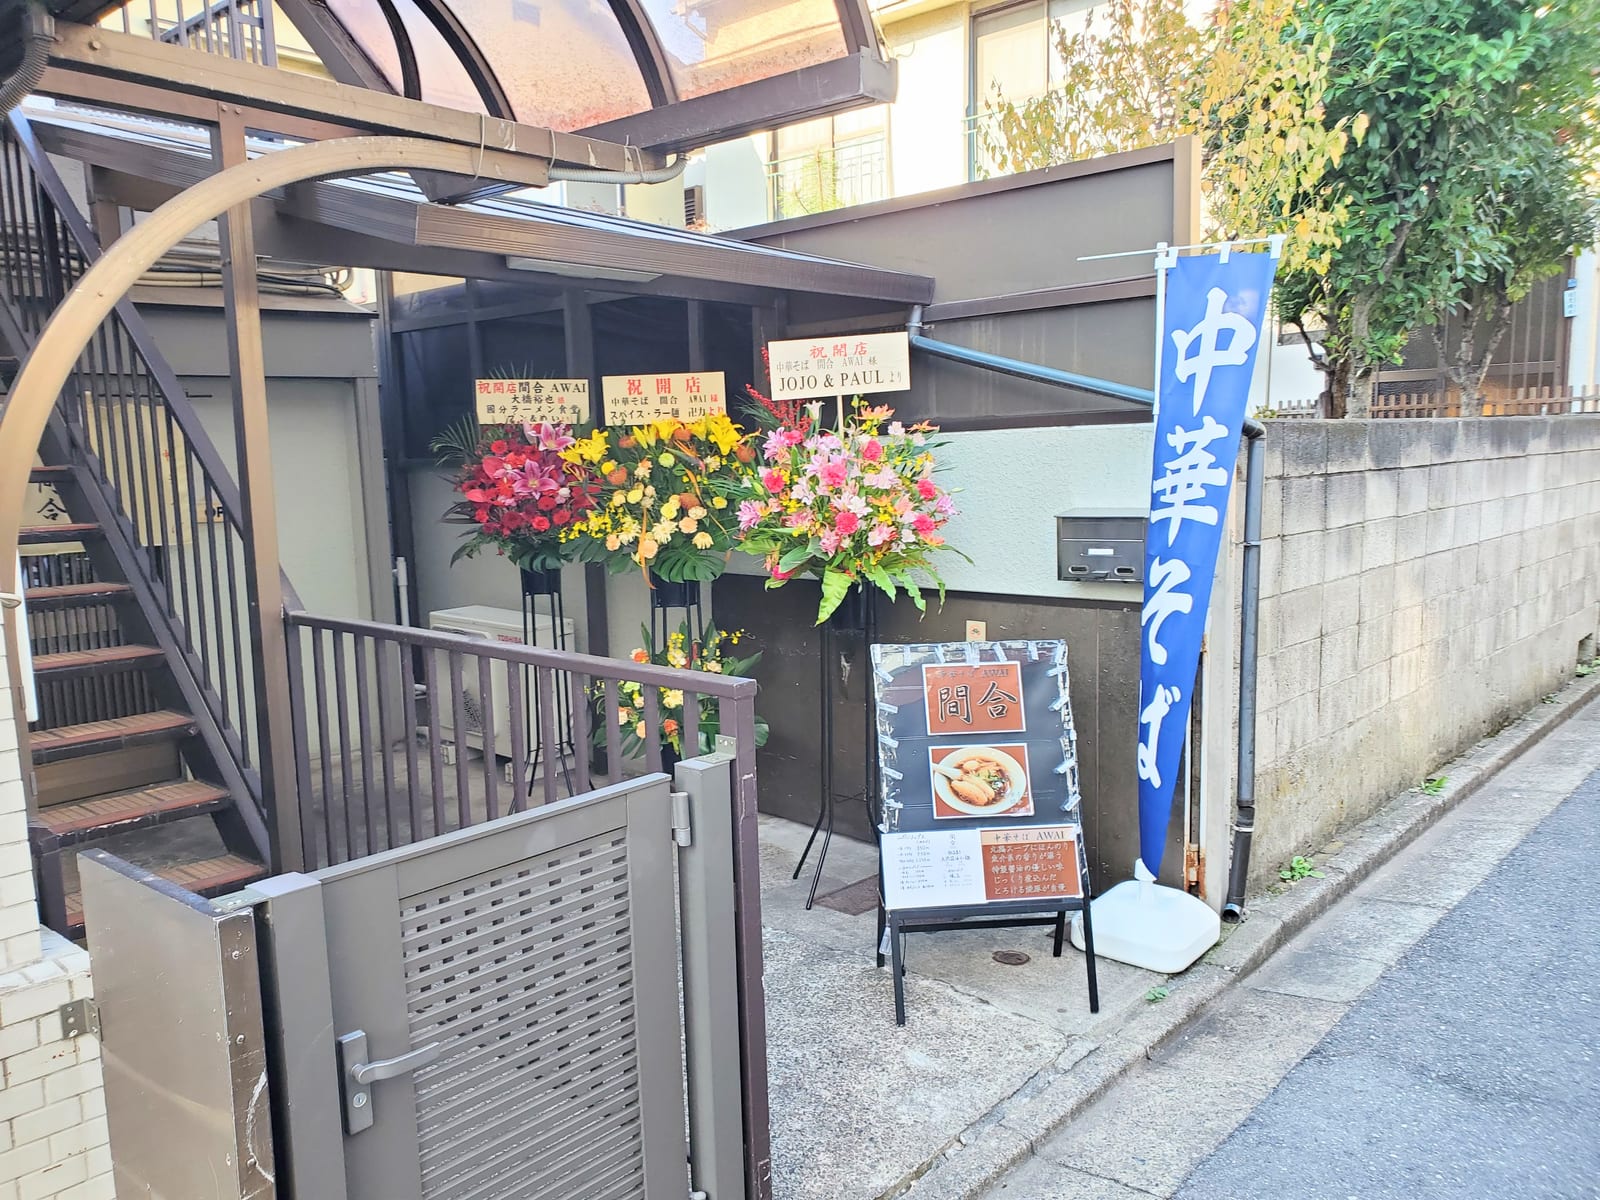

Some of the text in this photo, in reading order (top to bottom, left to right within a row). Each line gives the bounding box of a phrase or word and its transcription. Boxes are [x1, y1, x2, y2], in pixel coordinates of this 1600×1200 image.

[810, 342, 868, 359] 祝開店
[478, 381, 586, 394] 祝開店 間合 AWAI
[627, 376, 701, 395] 祝開店
[780, 375, 818, 391] JOJO
[824, 374, 834, 388] &
[841, 370, 884, 387] PAUL
[611, 397, 649, 406] 中華そば
[1138, 287, 1256, 788] 中華そば
[938, 680, 1018, 725] 間合
[1036, 830, 1065, 840] AWAI
